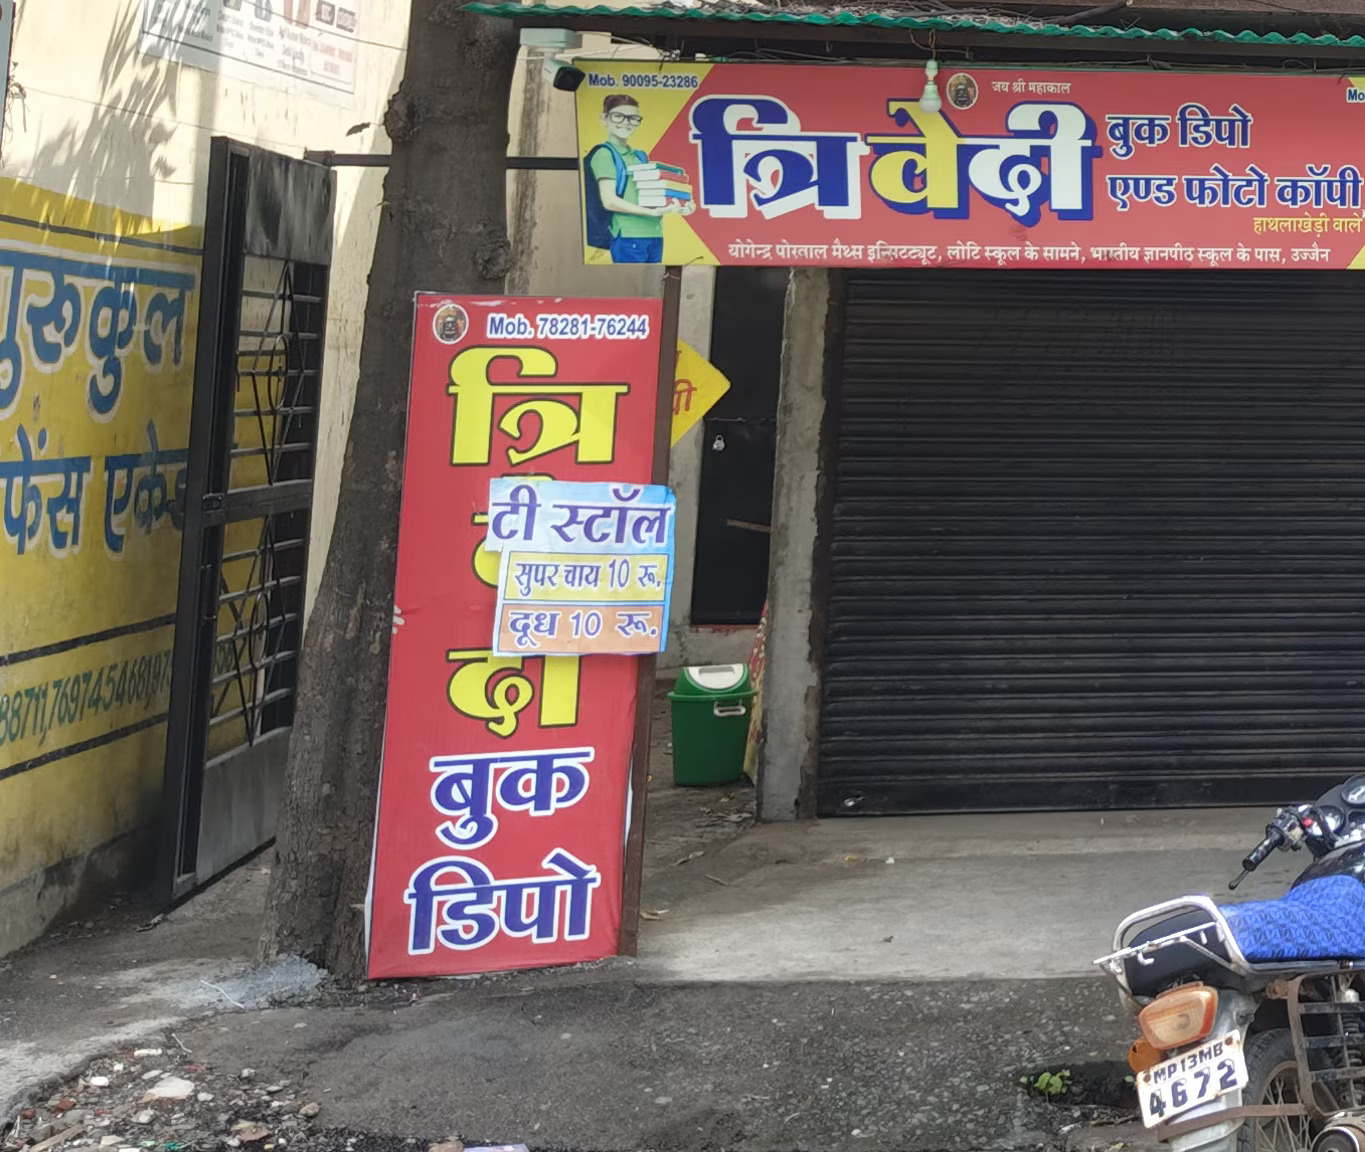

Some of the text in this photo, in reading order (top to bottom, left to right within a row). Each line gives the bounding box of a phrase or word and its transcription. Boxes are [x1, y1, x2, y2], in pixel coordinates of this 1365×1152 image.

[588, 73, 698, 89] Mob. 90095-23286
[1105, 102, 1254, 160] बुक डिपो
[1106, 163, 1365, 212] एण्ड फोटो कॉपी
[1332, 215, 1363, 234] वाले
[984, 244, 1021, 266] स्कूल
[1024, 241, 1039, 261] के
[1197, 246, 1233, 268] स्कूल
[1236, 243, 1251, 263] के
[488, 314, 649, 338] Mob. 78281-76244
[491, 483, 672, 544] टी स्टॉल
[514, 560, 559, 596] सुपर
[564, 562, 601, 589] चाय
[608, 558, 630, 588] 10
[508, 610, 560, 646] दूध
[570, 611, 603, 637] 10
[429, 746, 596, 849] बुक
[403, 847, 602, 955] डिपो
[1153, 1042, 1224, 1084] MP13MB
[1149, 1058, 1237, 1117] 4672
